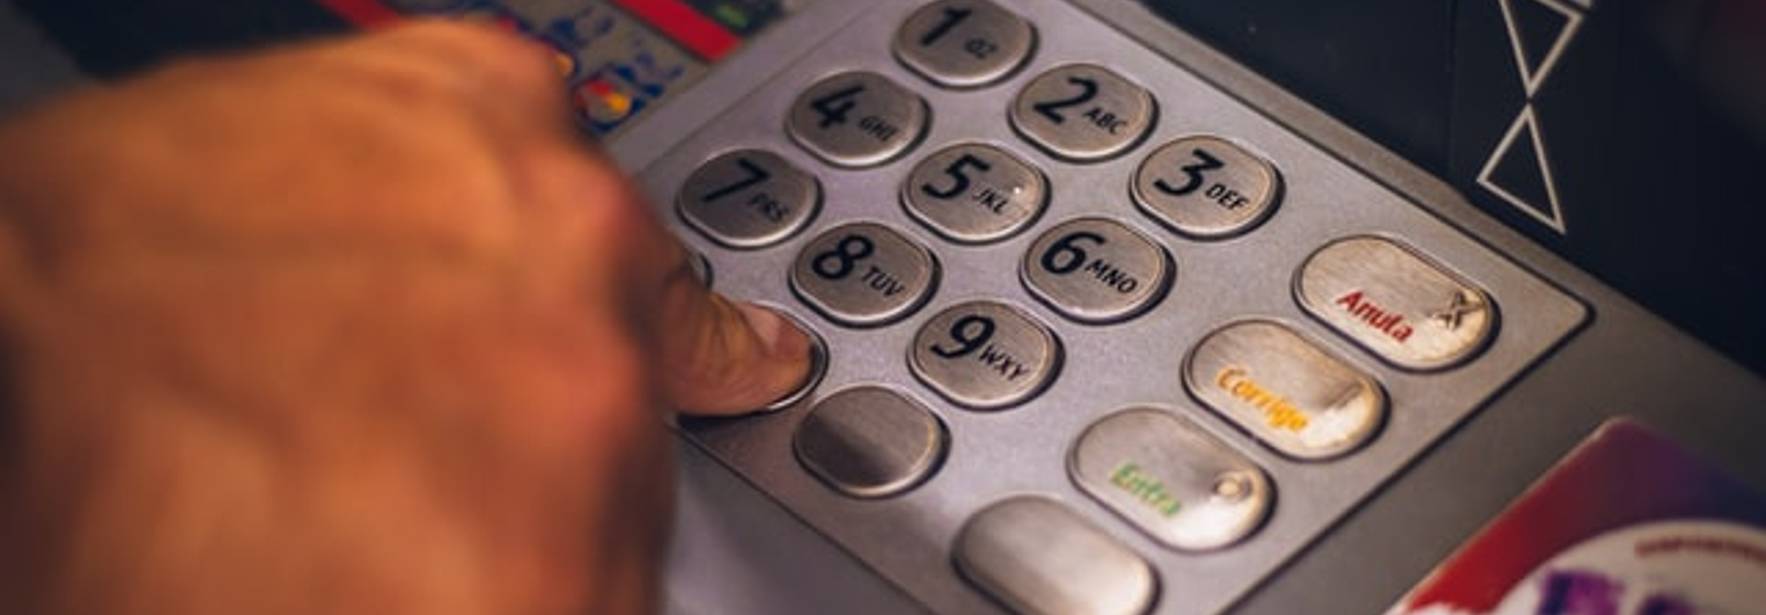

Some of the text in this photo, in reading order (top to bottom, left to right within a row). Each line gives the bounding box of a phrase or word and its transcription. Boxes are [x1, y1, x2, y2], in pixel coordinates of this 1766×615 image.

[920, 8, 972, 46] 1
[811, 84, 897, 141] 4 GHI
[1034, 77, 1128, 135] 2 ABC
[703, 159, 770, 201] 7
[922, 154, 1008, 214] 5 JKL
[1155, 149, 1249, 211] 3 DEF
[812, 234, 904, 297] 8 TUV
[1041, 232, 1136, 294] 6 MNO
[1337, 291, 1413, 343] Anula
[931, 315, 1029, 381] 9 WXY
[1217, 369, 1308, 432] Corrige
[1111, 464, 1181, 516] Entra
